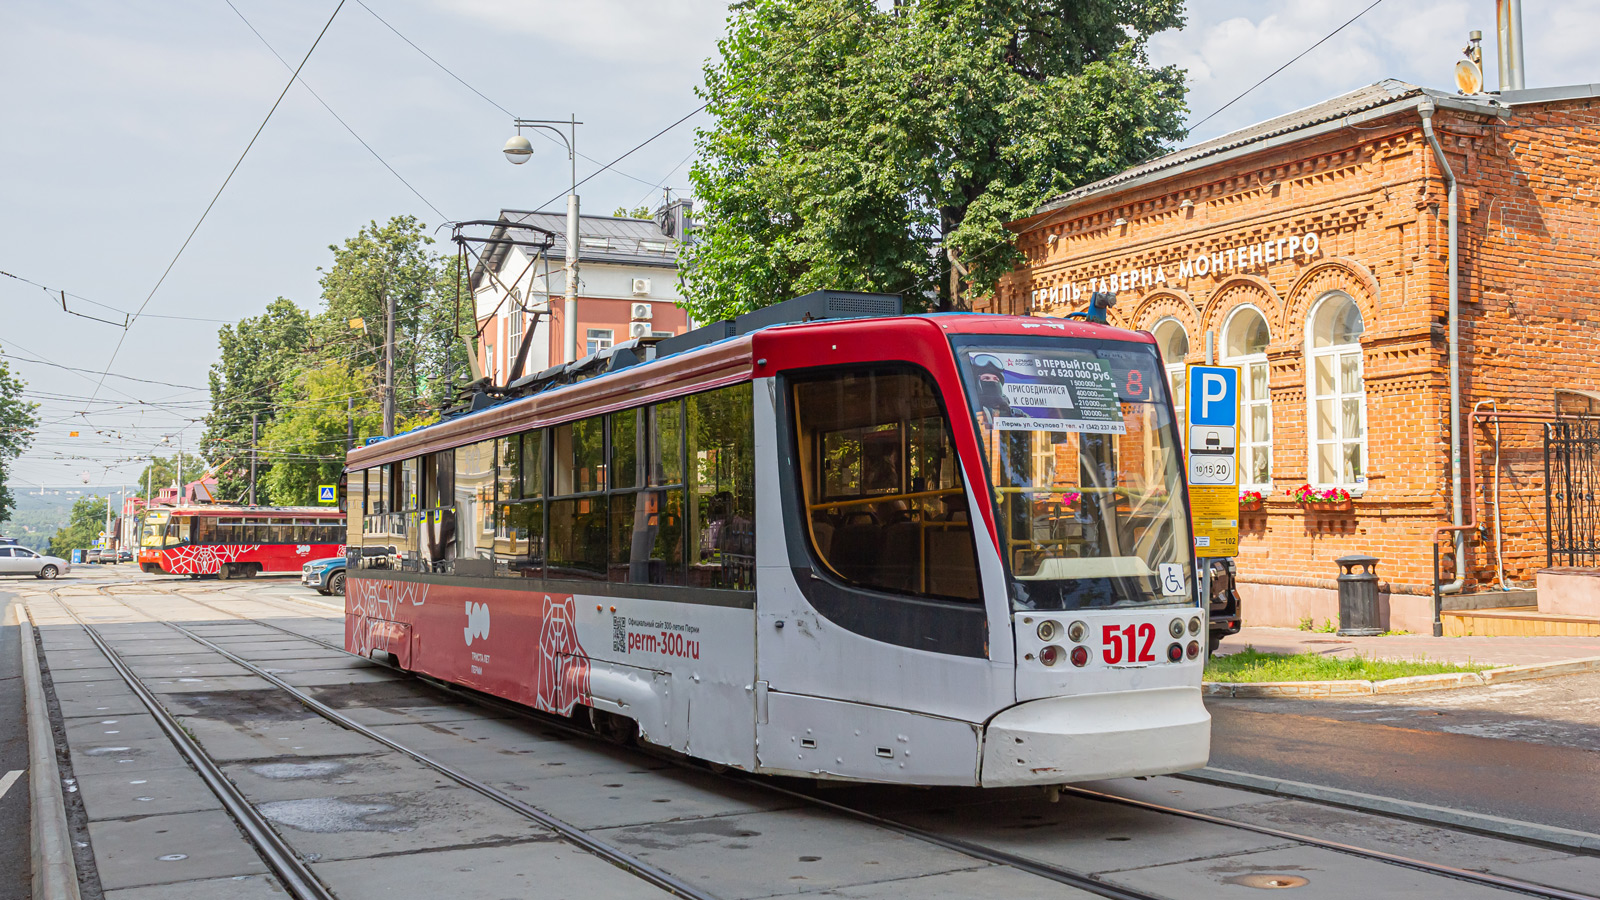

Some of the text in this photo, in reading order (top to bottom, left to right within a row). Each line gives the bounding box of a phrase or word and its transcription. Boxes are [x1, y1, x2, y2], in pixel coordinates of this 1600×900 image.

[1178, 232, 1319, 279] МОНТЕНЕГРО
[1035, 359, 1101, 372] В ПЕРВЫЙ ГОД
[1038, 369, 1048, 377] от
[1092, 371, 1113, 381] руб.
[1126, 369, 1143, 395] 8
[1008, 384, 1066, 395] ПРИСОЕДИНЯЙСЯ
[1013, 397, 1047, 406] К СВОИМ!
[1002, 420, 1022, 428] Пермь
[1033, 421, 1060, 429] Окулова
[1204, 465, 1213, 474] 15
[1216, 464, 1227, 474] 20
[628, 617, 655, 627] Официальный
[655, 620, 664, 630] сайт
[685, 623, 700, 634] Перми
[628, 631, 700, 660] perm-300.ru
[1102, 622, 1156, 664] 512
